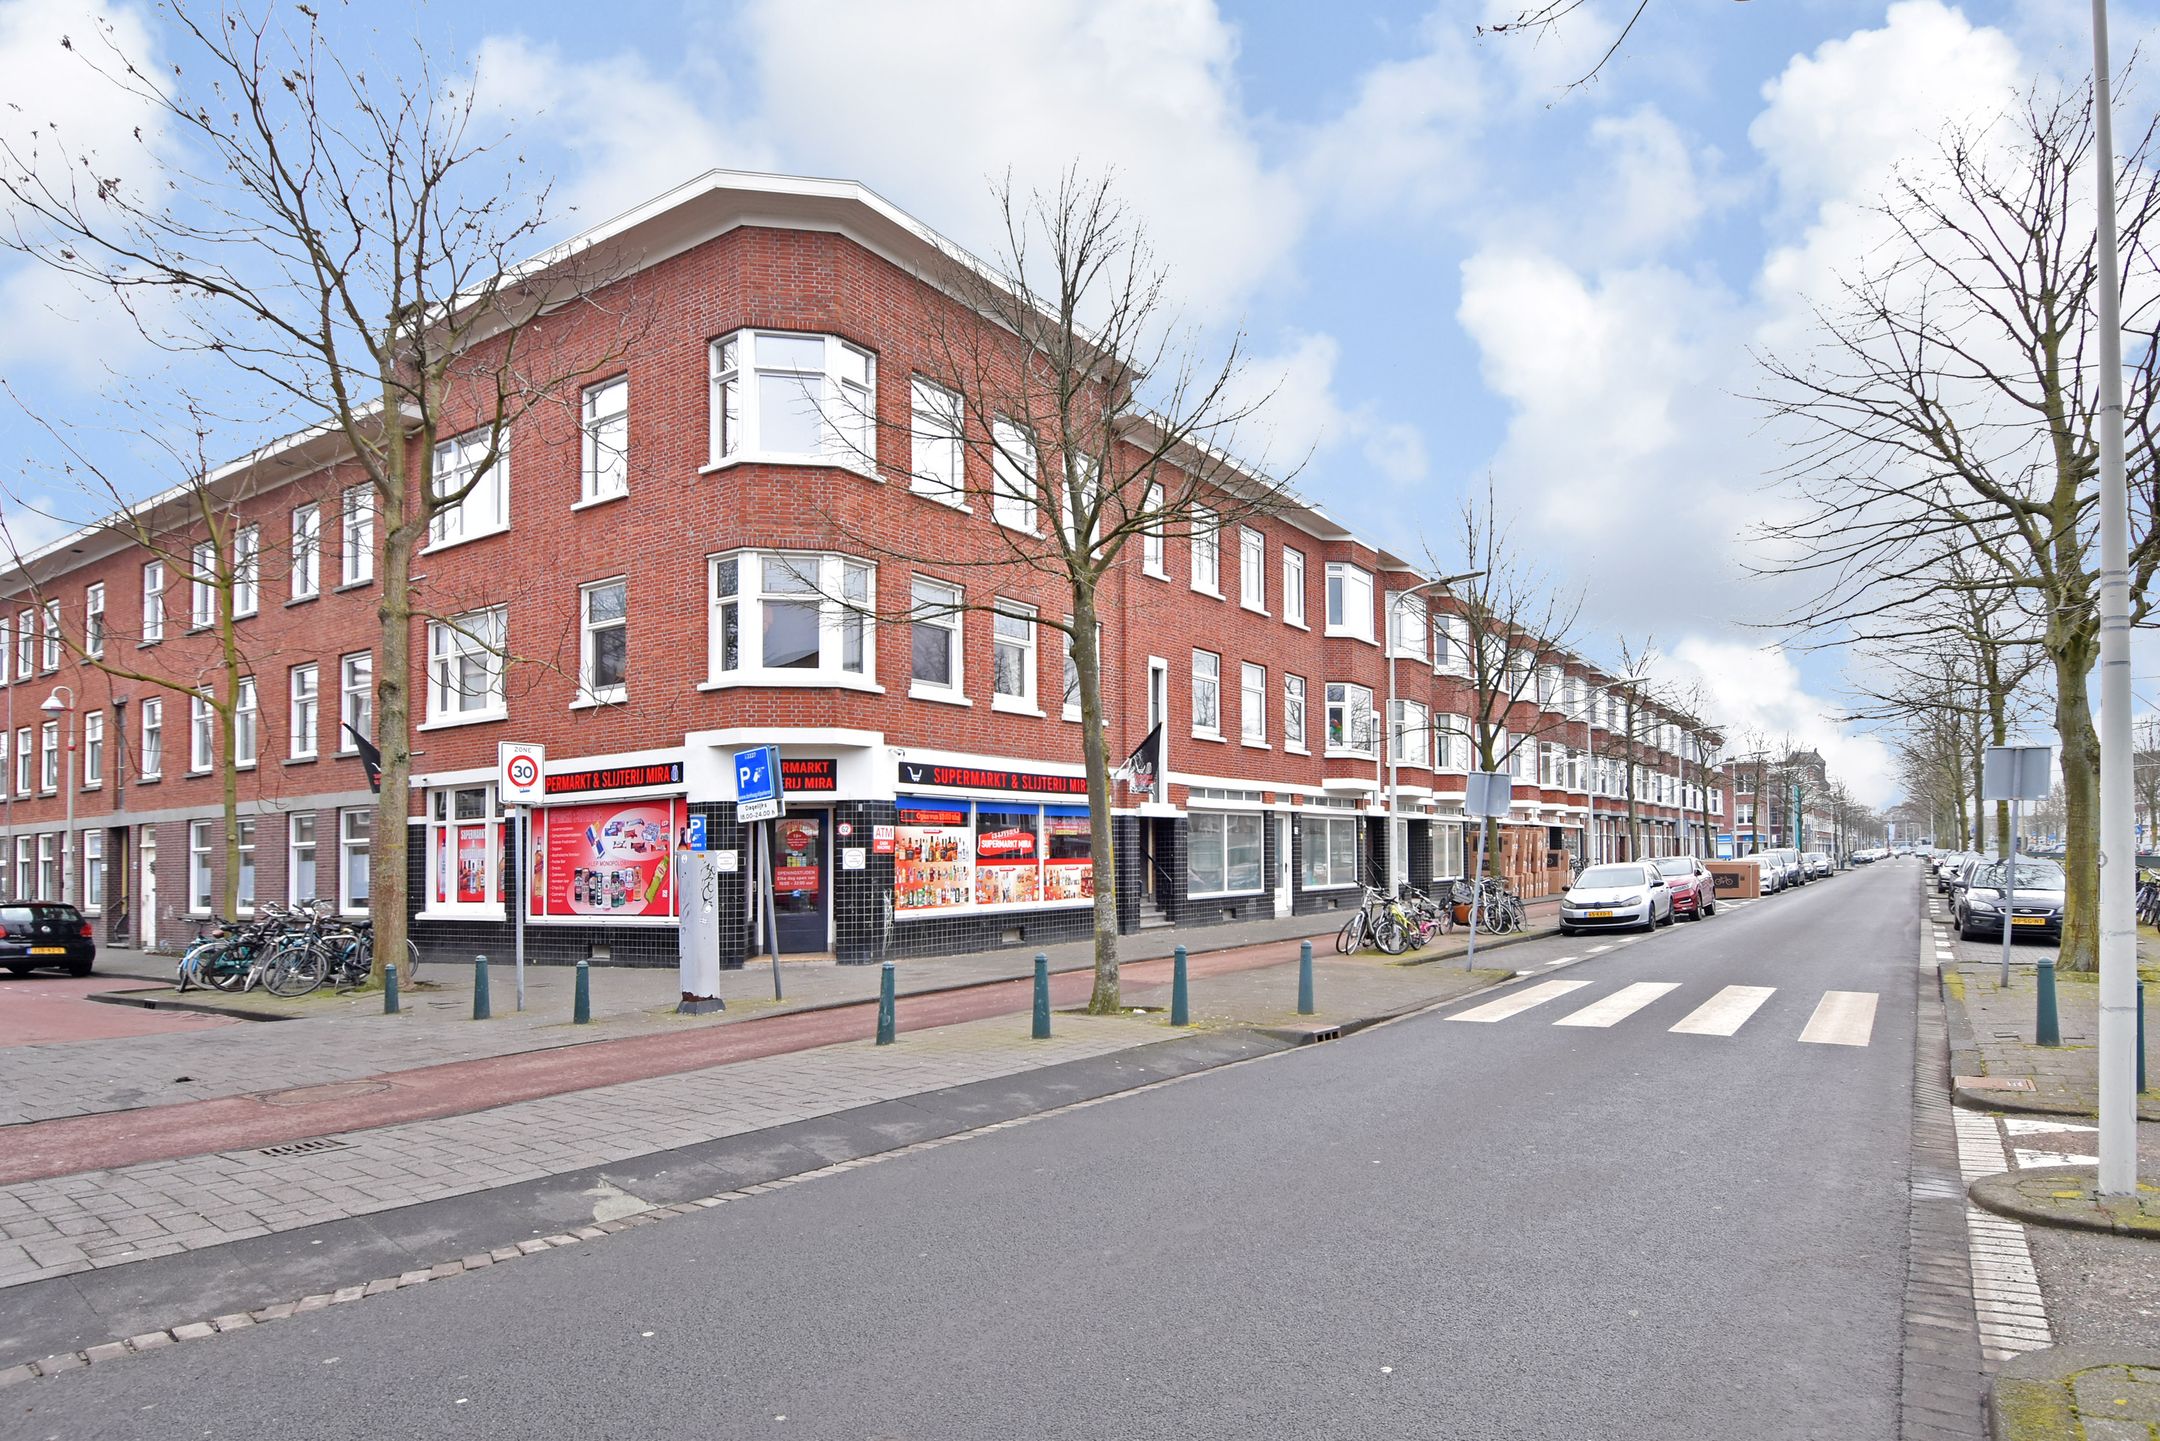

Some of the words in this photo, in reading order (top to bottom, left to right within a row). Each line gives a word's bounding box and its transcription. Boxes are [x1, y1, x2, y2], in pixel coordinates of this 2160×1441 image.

[514, 746, 532, 754] ZONE
[513, 765, 533, 779] 30
[593, 772, 600, 788] &
[602, 766, 645, 788] SLIJTERIJ
[646, 765, 671, 784] MIRA
[740, 766, 751, 788] P
[804, 777, 833, 789] MIRA
[933, 767, 1008, 788] SUPERMARKT
[1011, 774, 1019, 789] &
[1022, 775, 1067, 792] SLIJTERIJ
[1069, 779, 1087, 793] MIR
[690, 818, 702, 835] P
[875, 827, 893, 839] ATM
[981, 839, 1018, 849] SUPERMARKT
